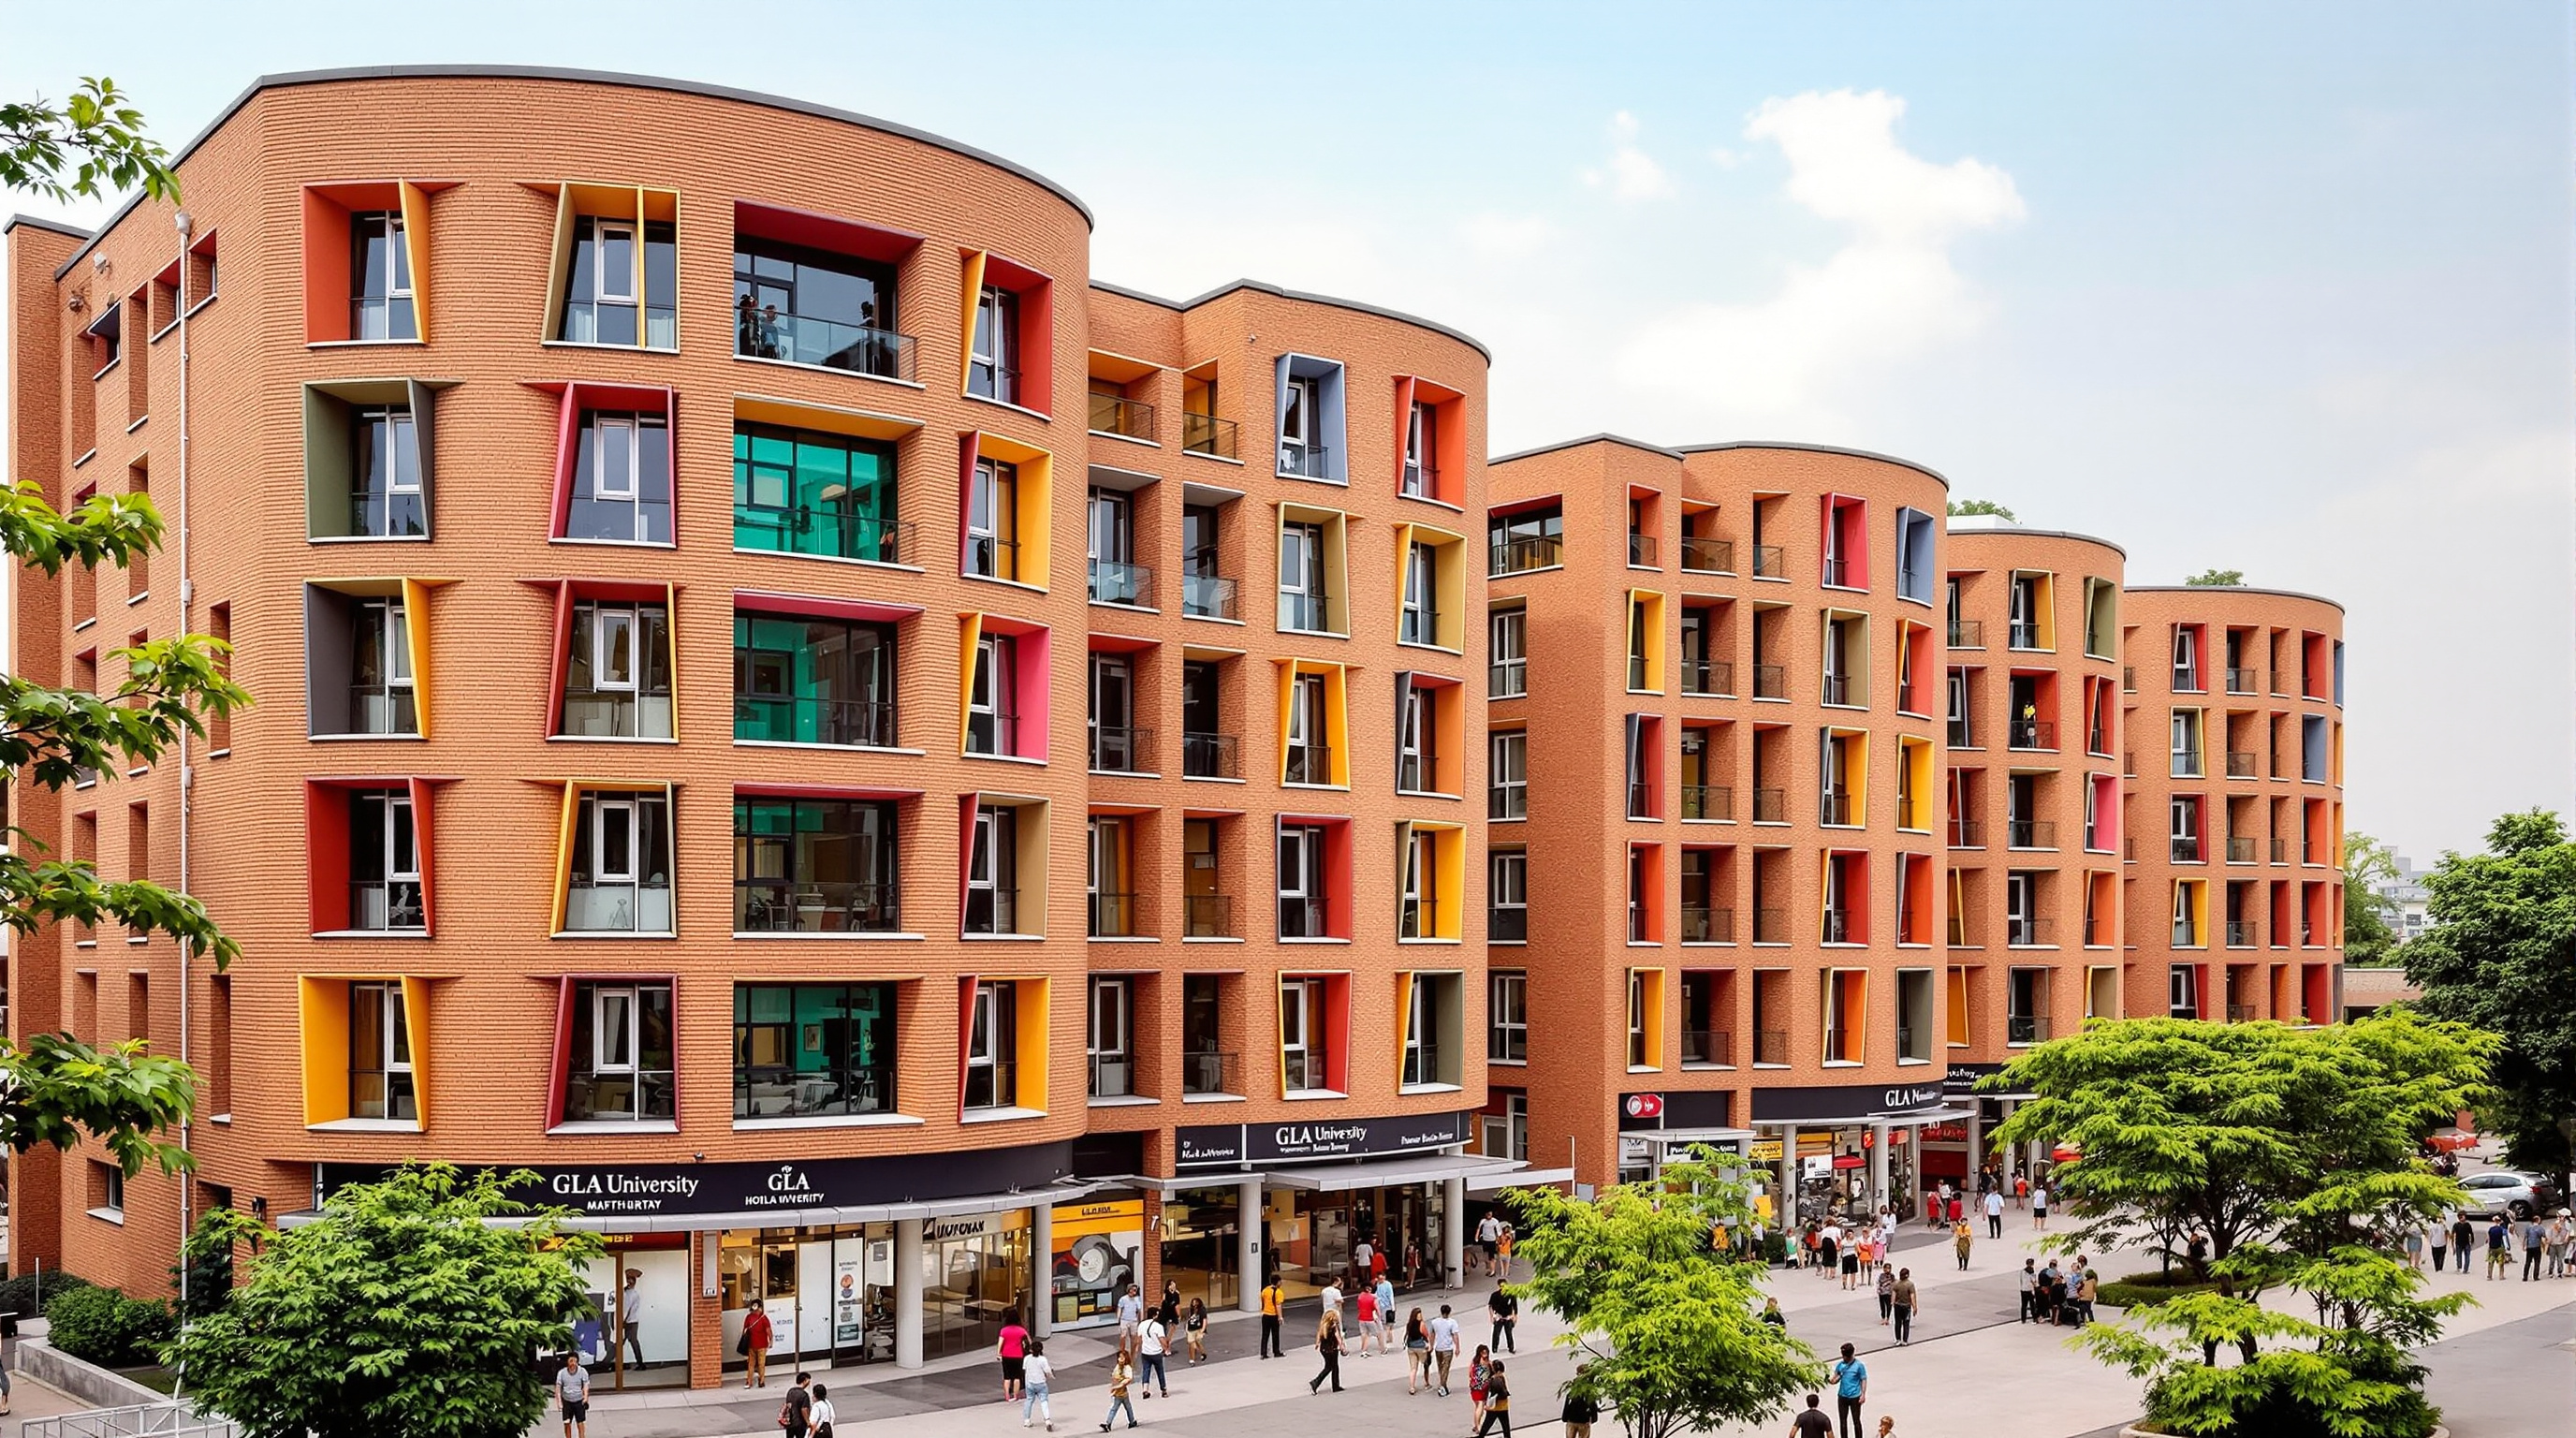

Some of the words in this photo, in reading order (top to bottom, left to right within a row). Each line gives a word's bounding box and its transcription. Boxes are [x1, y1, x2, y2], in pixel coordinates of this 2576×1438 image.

[1275, 1126, 1312, 1145] GLA
[552, 1174, 603, 1194] GLA
[607, 1174, 699, 1197] University
[768, 1172, 811, 1191] GLA
